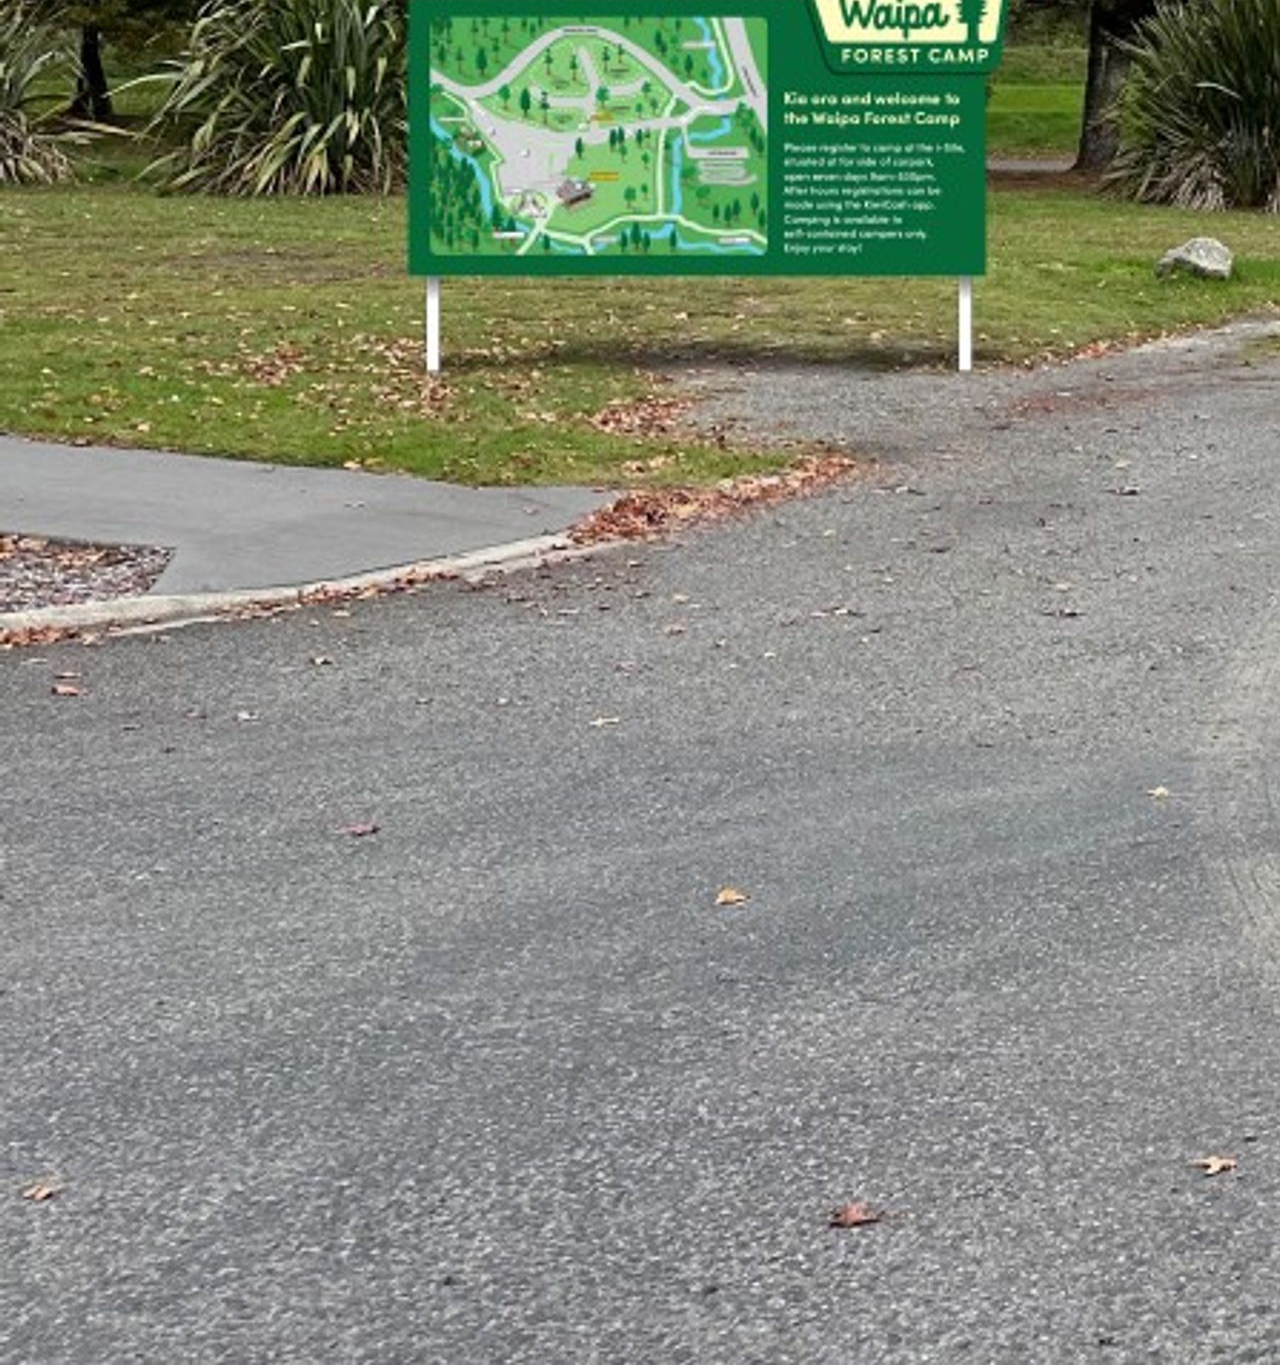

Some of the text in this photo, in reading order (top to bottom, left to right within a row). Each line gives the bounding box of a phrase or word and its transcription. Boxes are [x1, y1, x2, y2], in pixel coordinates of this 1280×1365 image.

[841, 48, 990, 64] FOREST CAMP
[784, 92, 961, 105] Kia ora and welcome to
[784, 112, 961, 128] the Waipa Forest Camp
[784, 143, 817, 153] Please
[819, 143, 857, 155] register
[873, 144, 902, 155] camp
